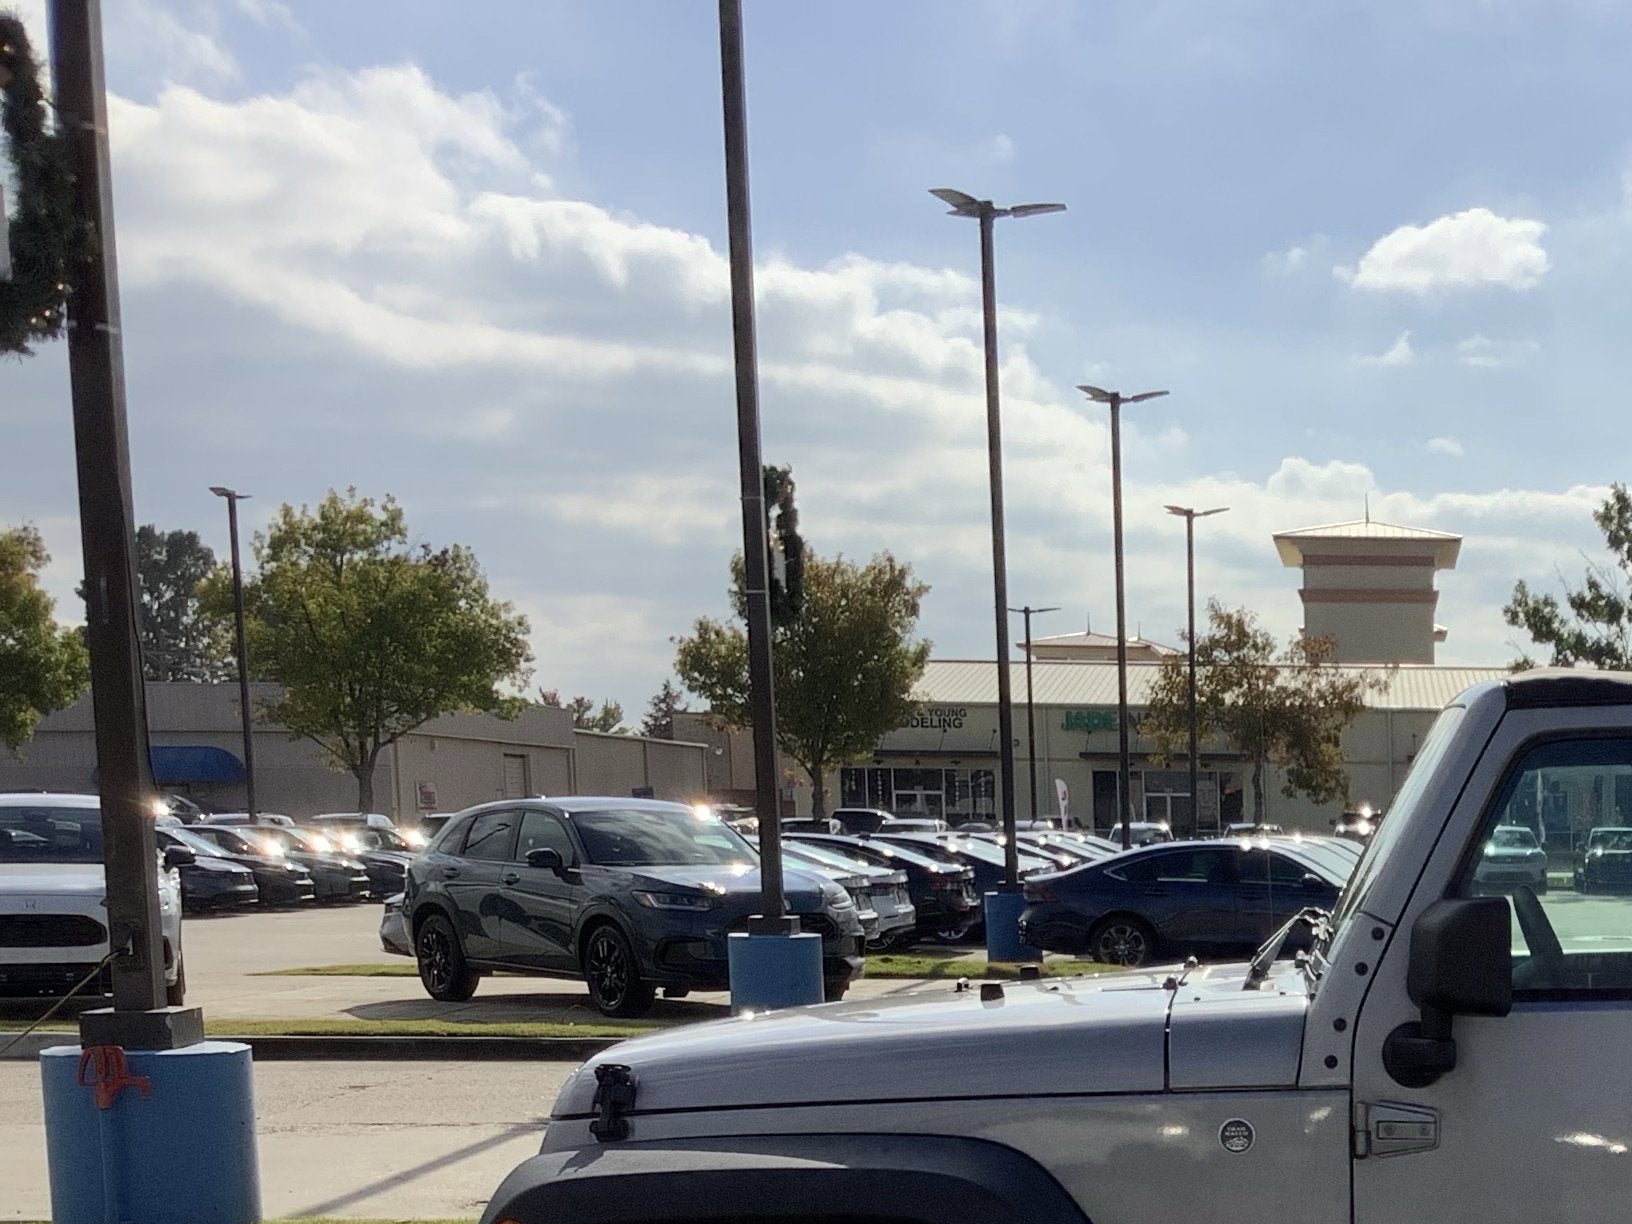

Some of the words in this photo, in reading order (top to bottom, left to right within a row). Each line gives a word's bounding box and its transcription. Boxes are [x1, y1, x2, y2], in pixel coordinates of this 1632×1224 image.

[927, 708, 967, 718] YOUNG
[899, 717, 963, 729] ODELING
[1061, 710, 1118, 731] JADE
